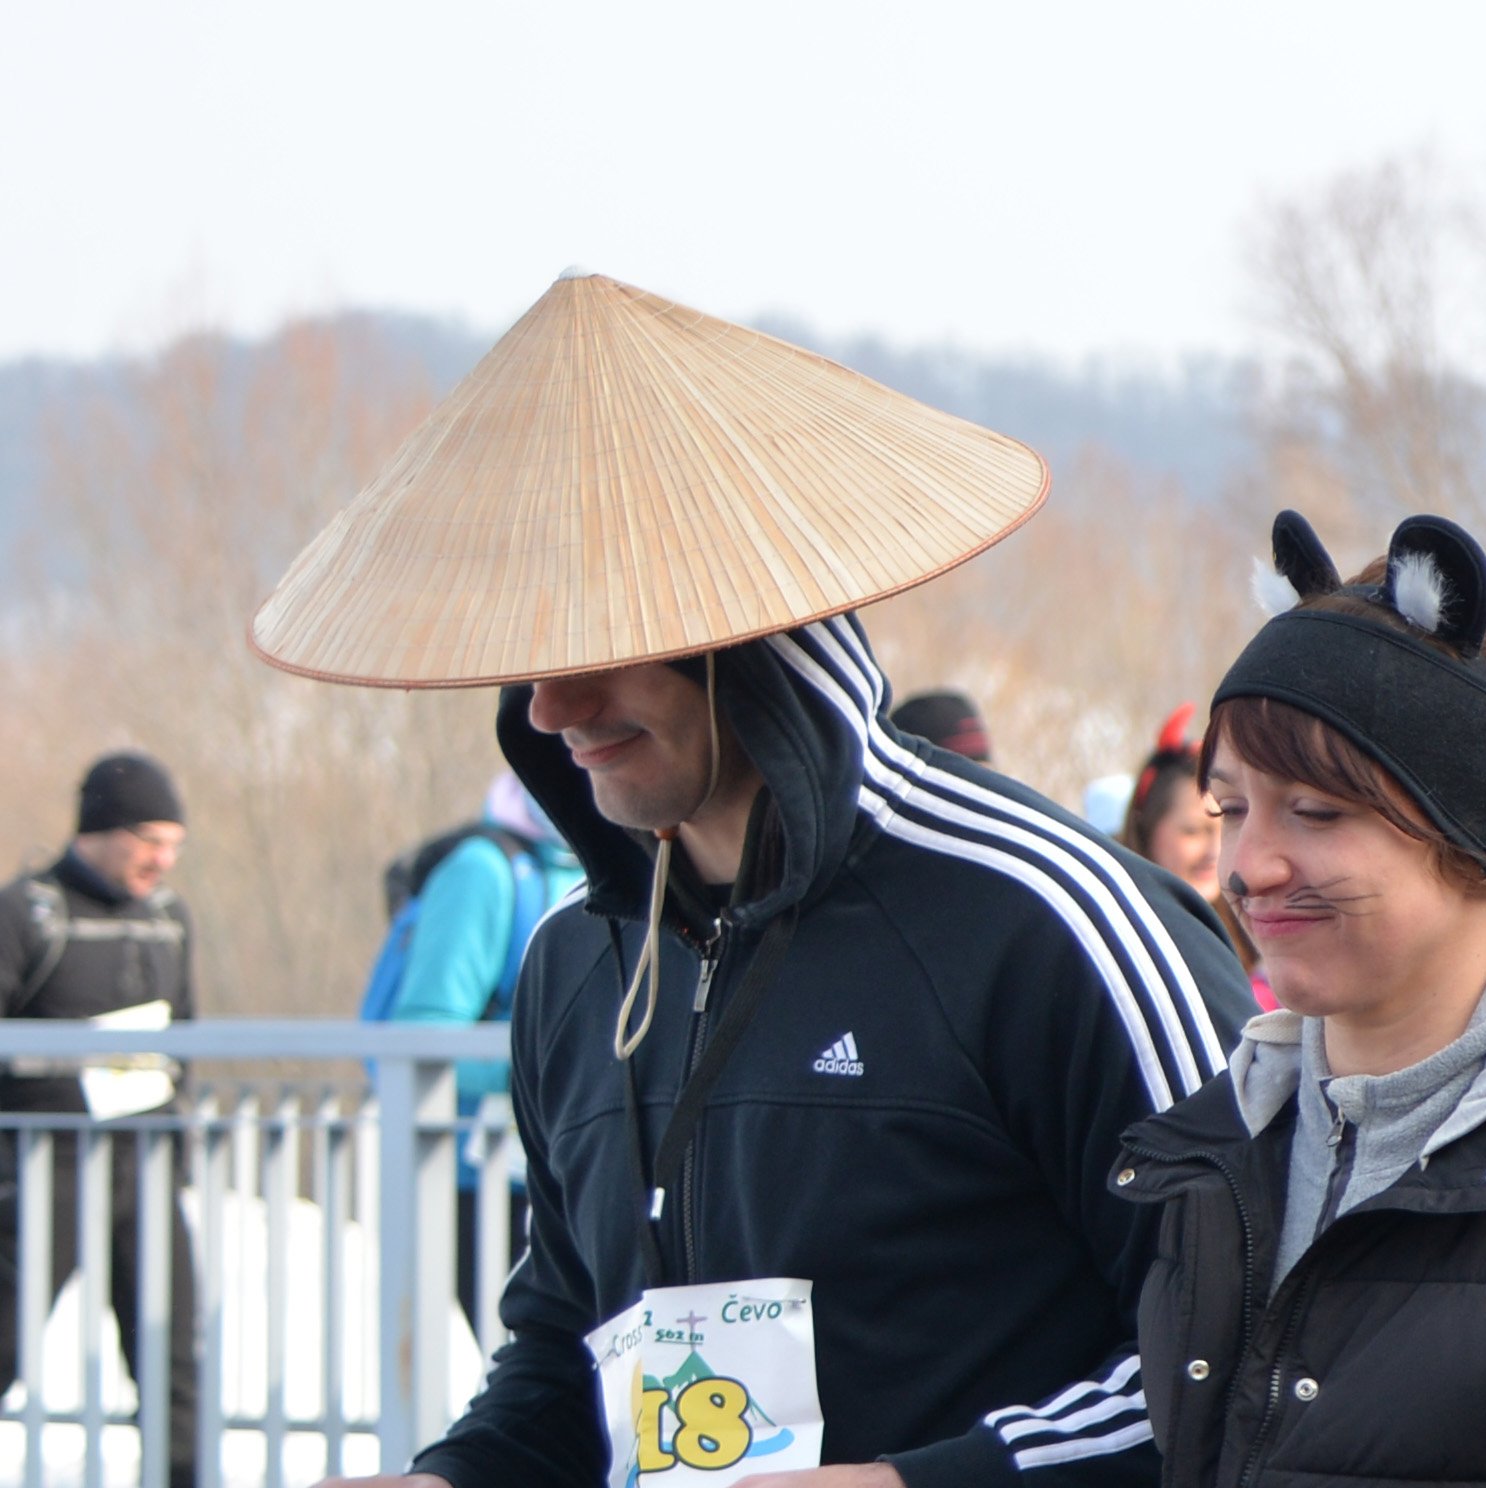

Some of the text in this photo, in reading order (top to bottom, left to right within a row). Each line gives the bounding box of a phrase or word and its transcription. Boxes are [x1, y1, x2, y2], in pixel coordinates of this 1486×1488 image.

[813, 1058, 865, 1076] adidas
[721, 1294, 782, 1324] Čevo
[636, 1376, 753, 1471] 18
